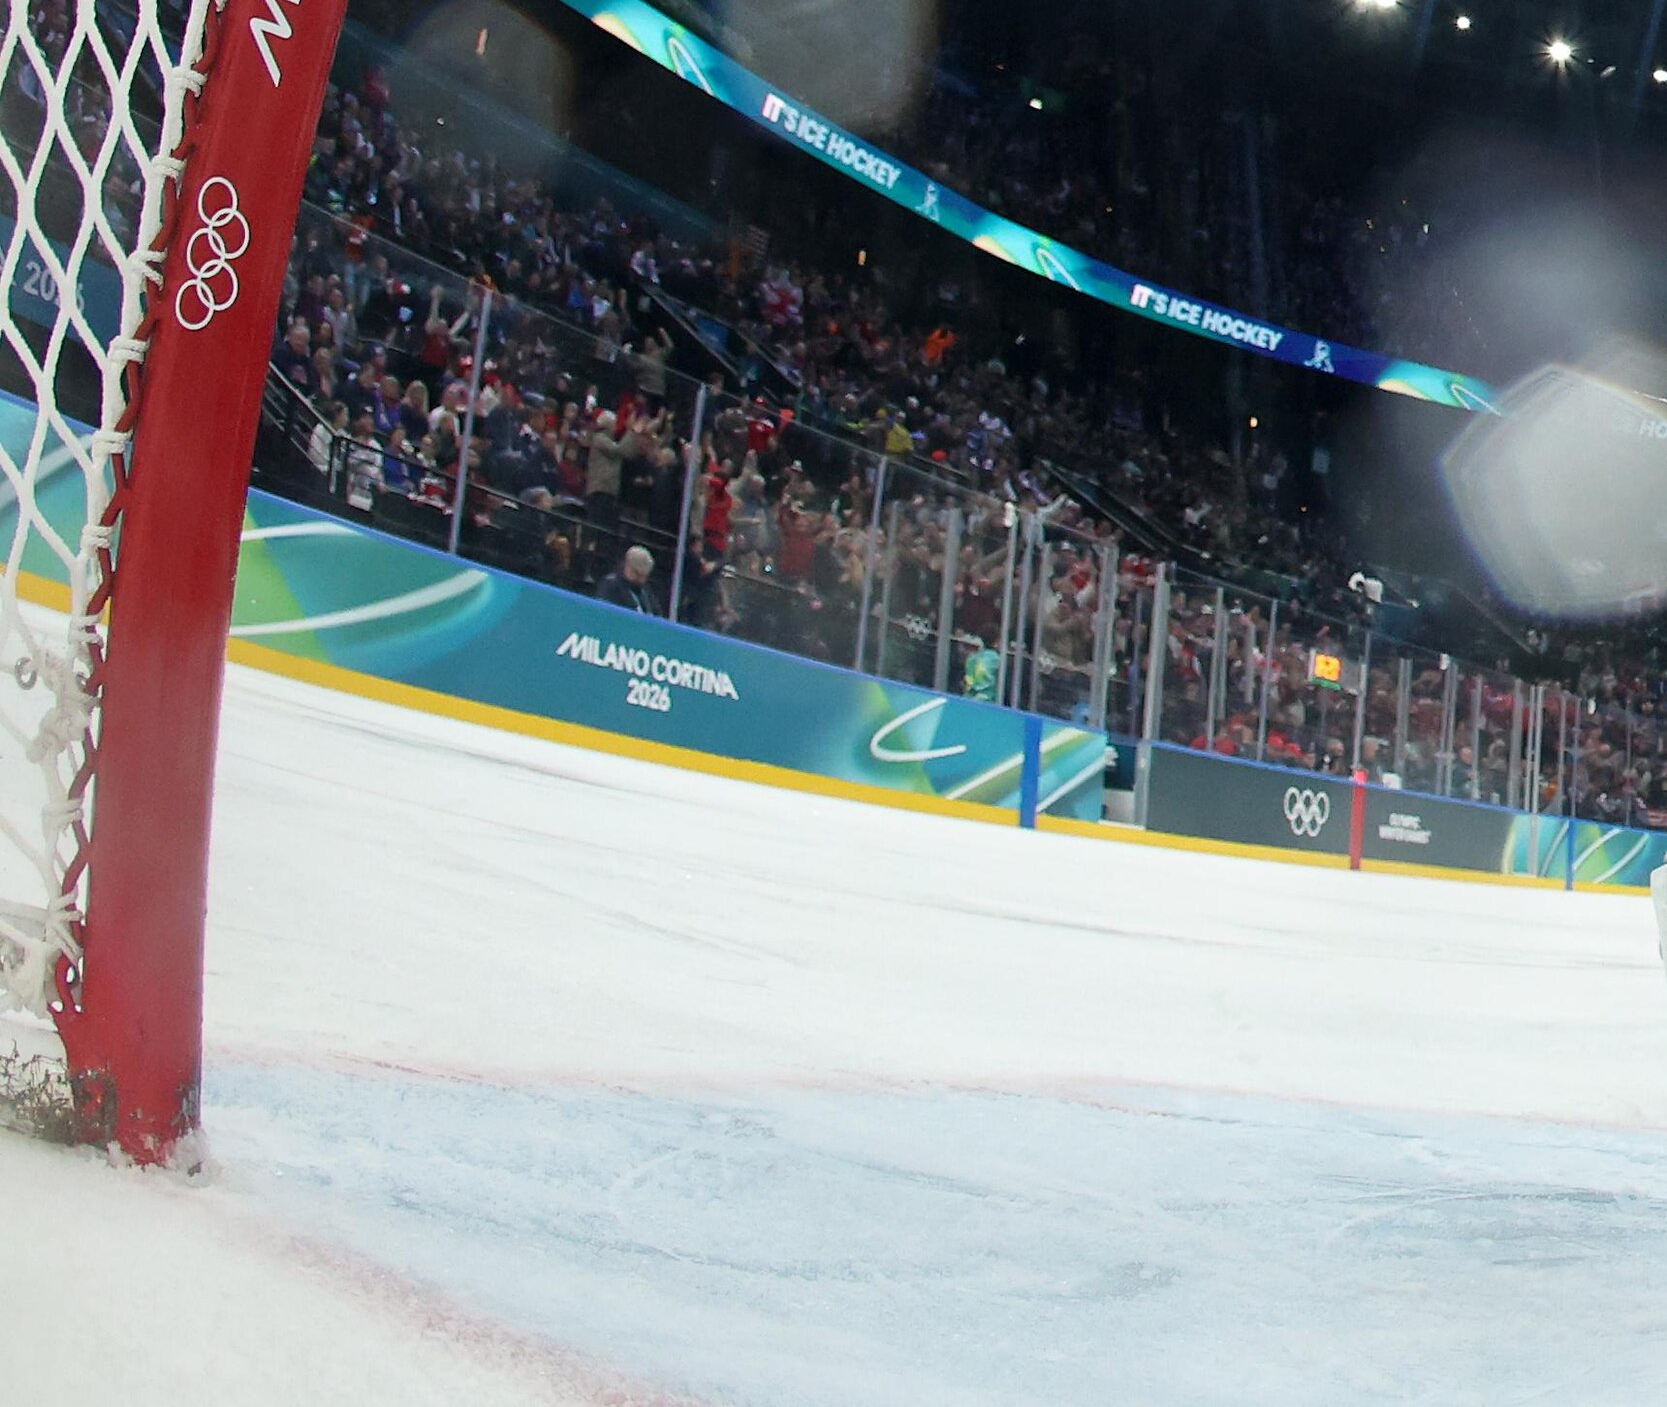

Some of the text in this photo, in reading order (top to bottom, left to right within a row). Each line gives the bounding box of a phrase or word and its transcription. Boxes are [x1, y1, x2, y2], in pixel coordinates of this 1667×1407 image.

[762, 92, 901, 189] IT'S ICE HOCKEY
[1130, 284, 1283, 351] IT'S ICE HOCKEY
[555, 632, 740, 701] MILANO CORTINA
[626, 677, 672, 712] 2026
